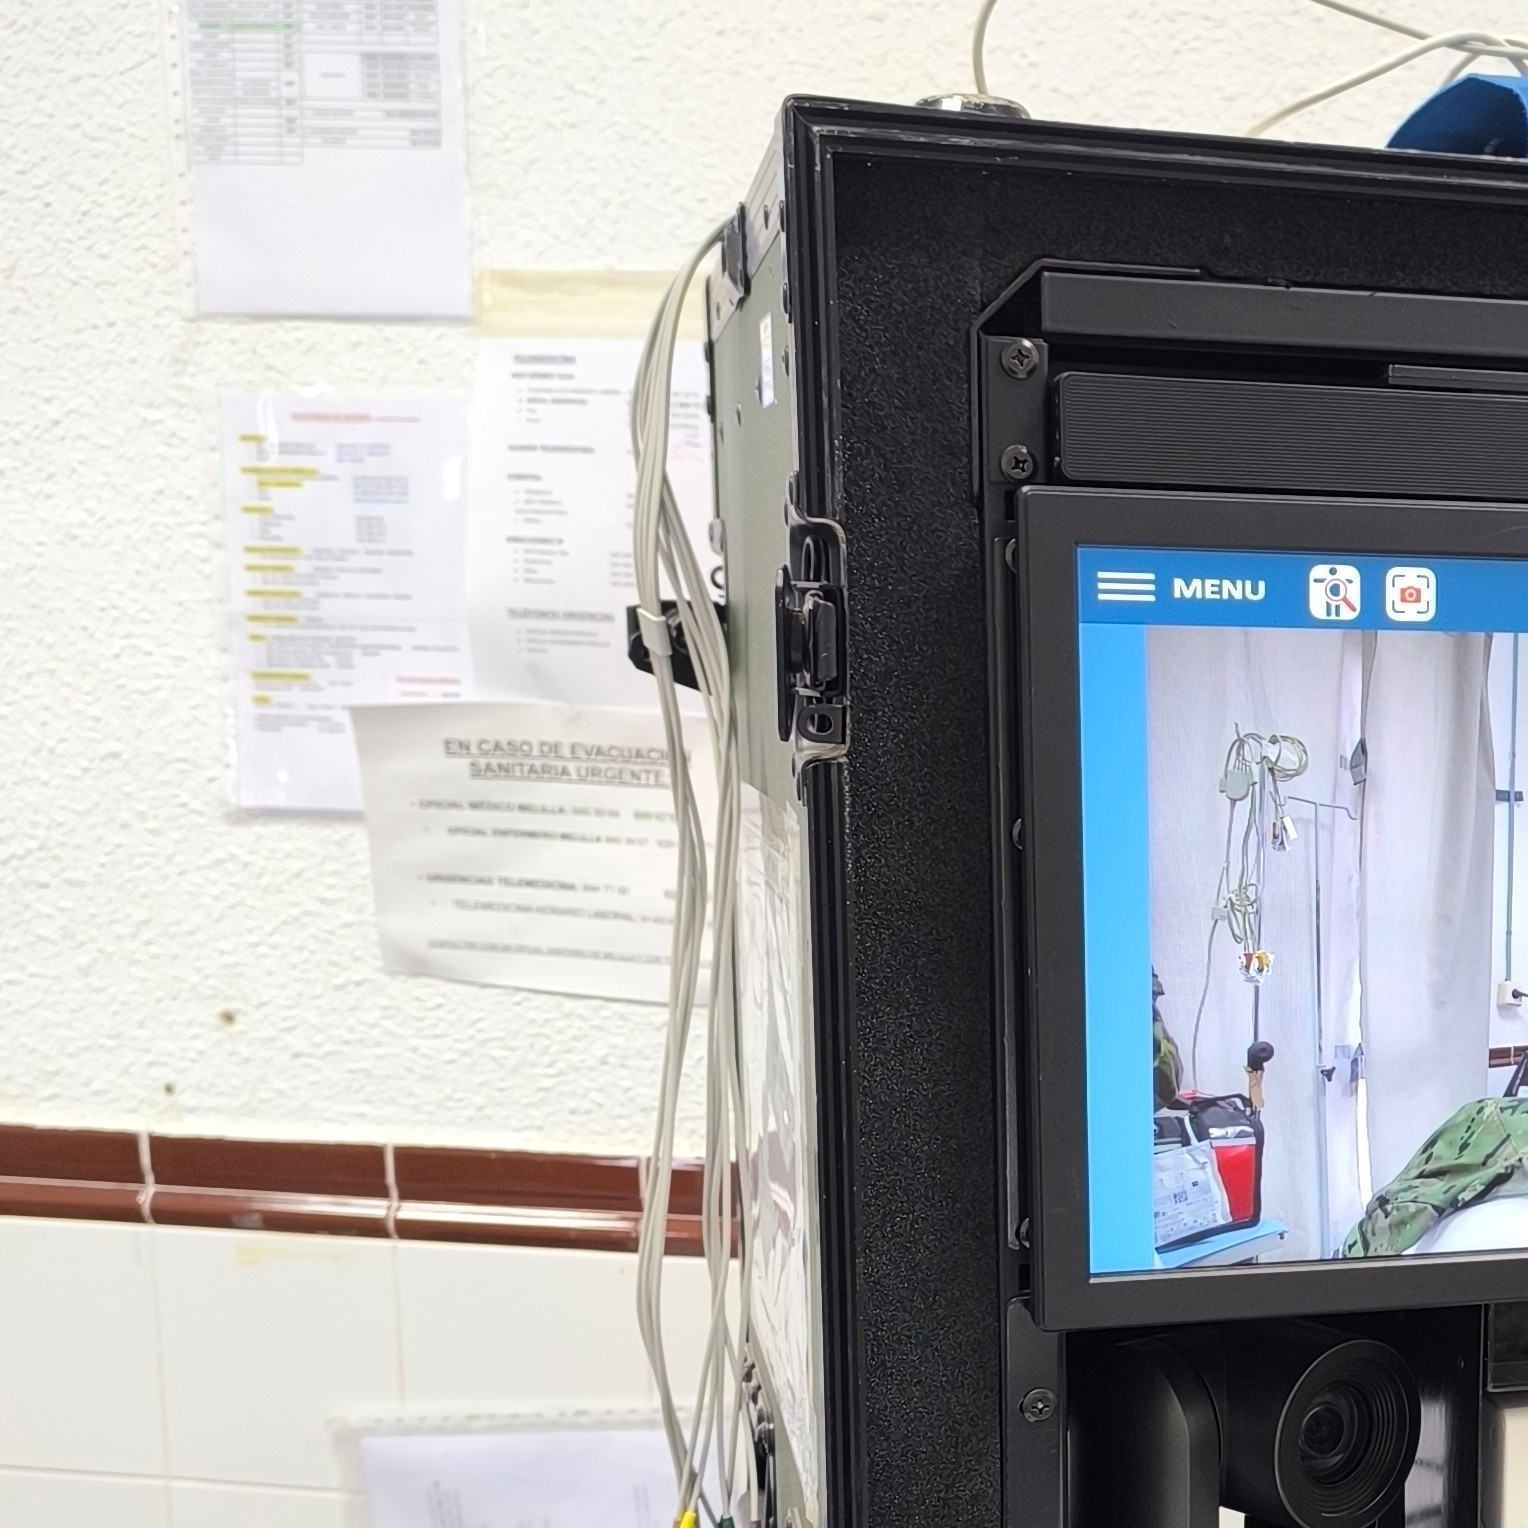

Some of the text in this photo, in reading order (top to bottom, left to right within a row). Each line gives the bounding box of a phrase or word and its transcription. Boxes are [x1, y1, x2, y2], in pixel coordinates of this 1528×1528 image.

[1172, 577, 1266, 601] MENU
[445, 738, 470, 755] EN
[477, 739, 533, 756] CASO
[539, 741, 561, 757] DE
[469, 761, 662, 784] SANITARIA URGENTE
